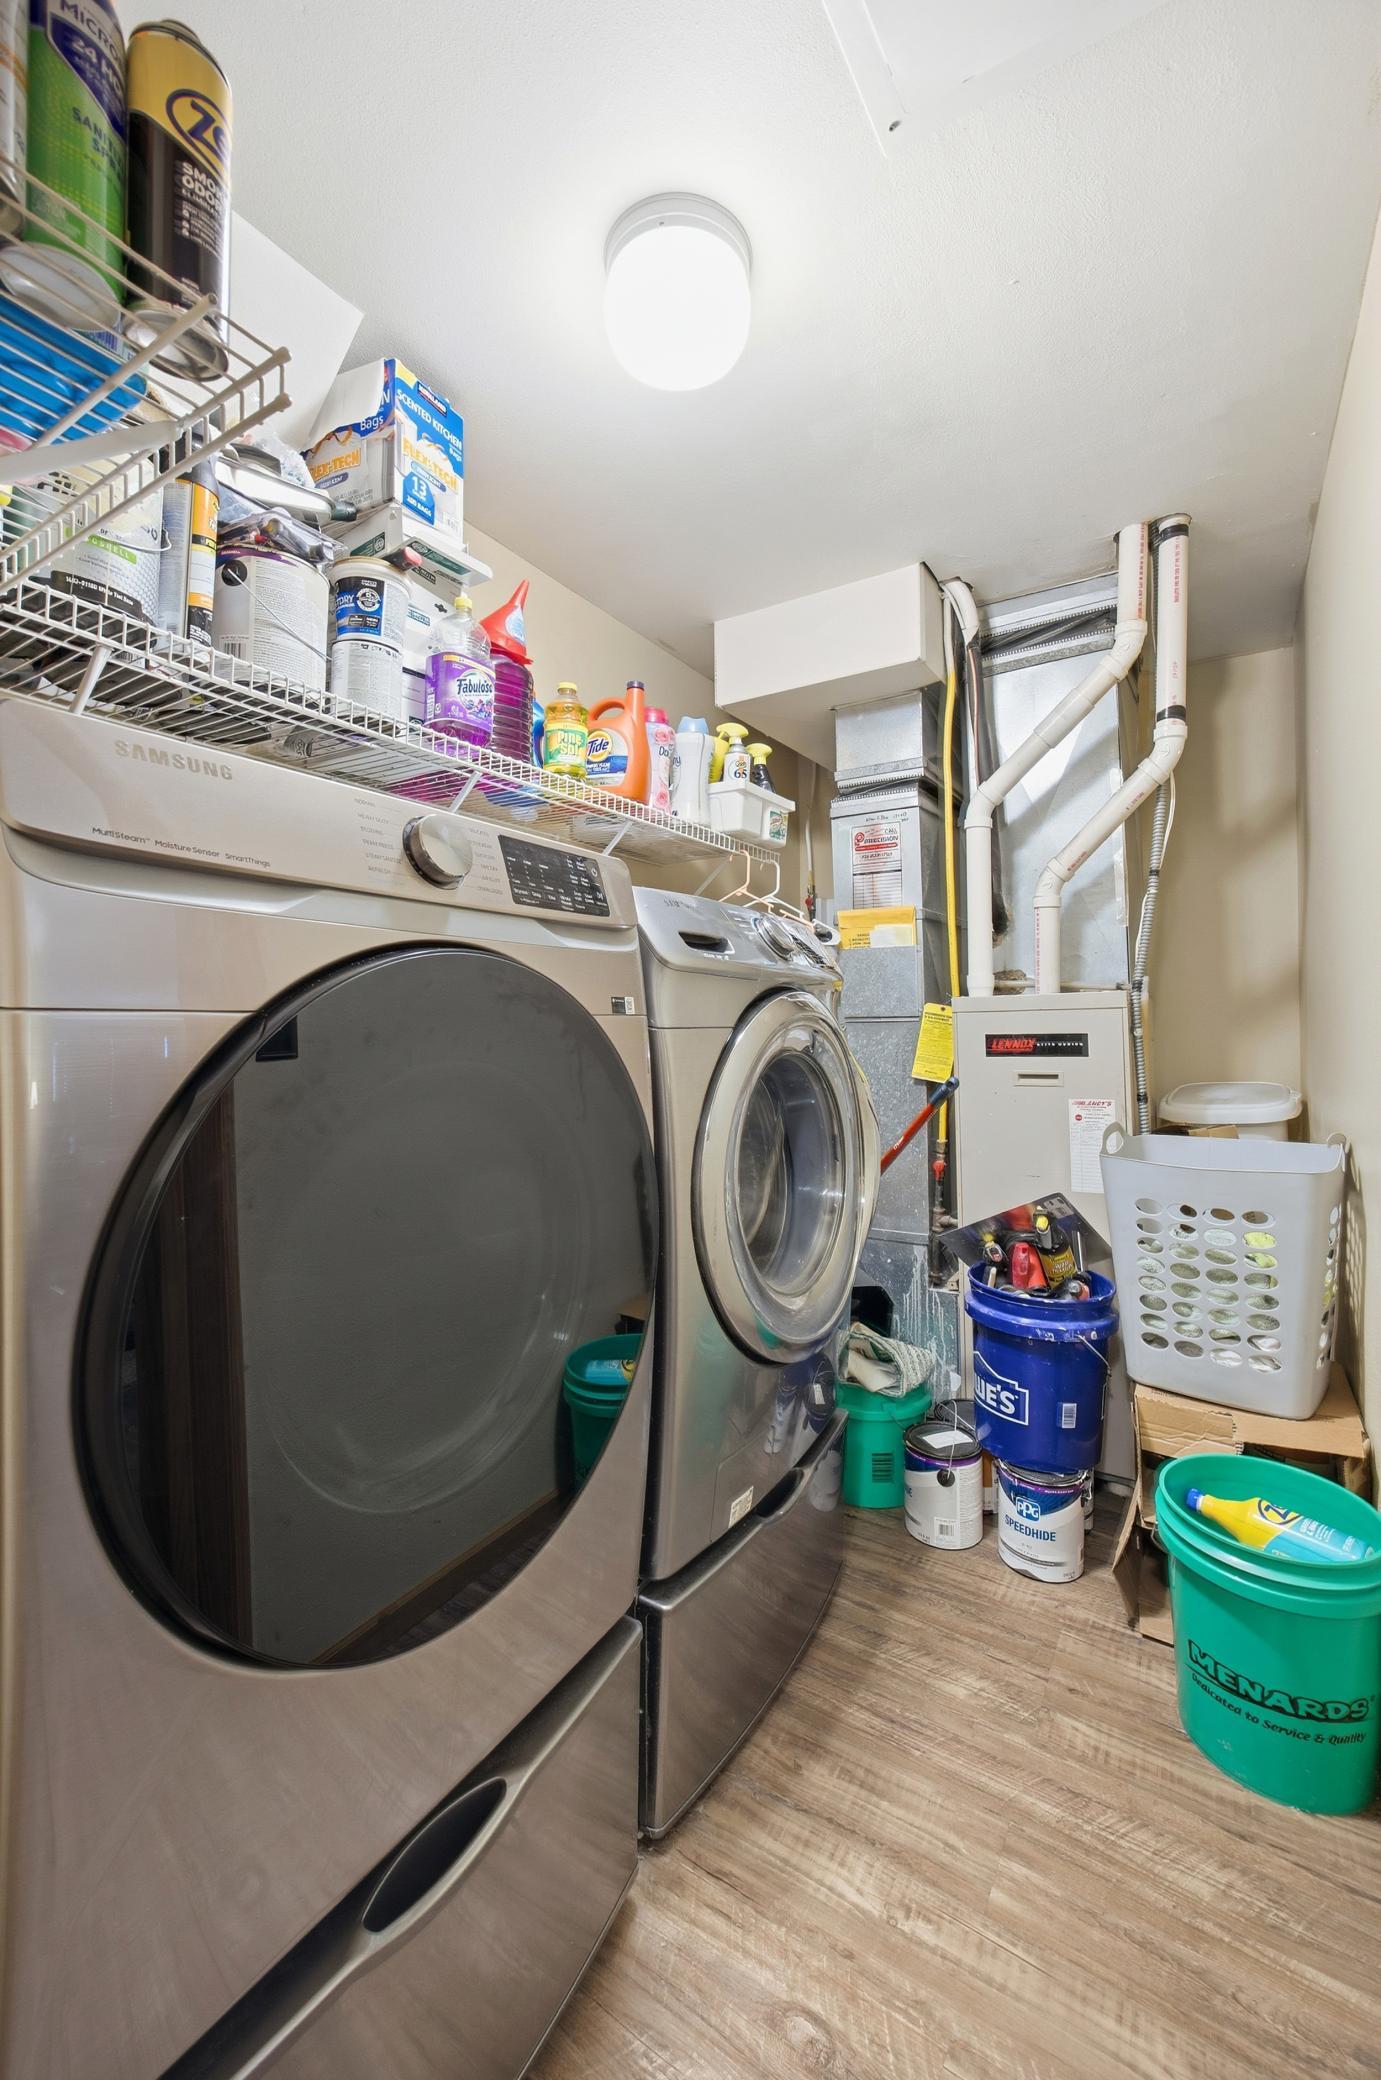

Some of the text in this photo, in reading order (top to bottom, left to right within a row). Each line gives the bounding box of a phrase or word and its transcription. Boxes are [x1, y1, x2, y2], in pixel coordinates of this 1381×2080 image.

[359, 415, 384, 430] Bags
[397, 390, 432, 426] SCENTED
[432, 419, 462, 448] KITCHEN
[411, 475, 428, 495] 13
[417, 502, 432, 518] BAGS
[587, 738, 610, 757] Tide
[114, 739, 234, 781] SAMSUNG
[154, 839, 191, 853] Moisture
[991, 1038, 1037, 1050] LENNOX
[1017, 1500, 1040, 1519] PPG
[1004, 1513, 1057, 1542] SPEEDHIDE
[1187, 1638, 1369, 1723] MENARDS
[1191, 1672, 1367, 1747] Dedicated to Service & Quality
